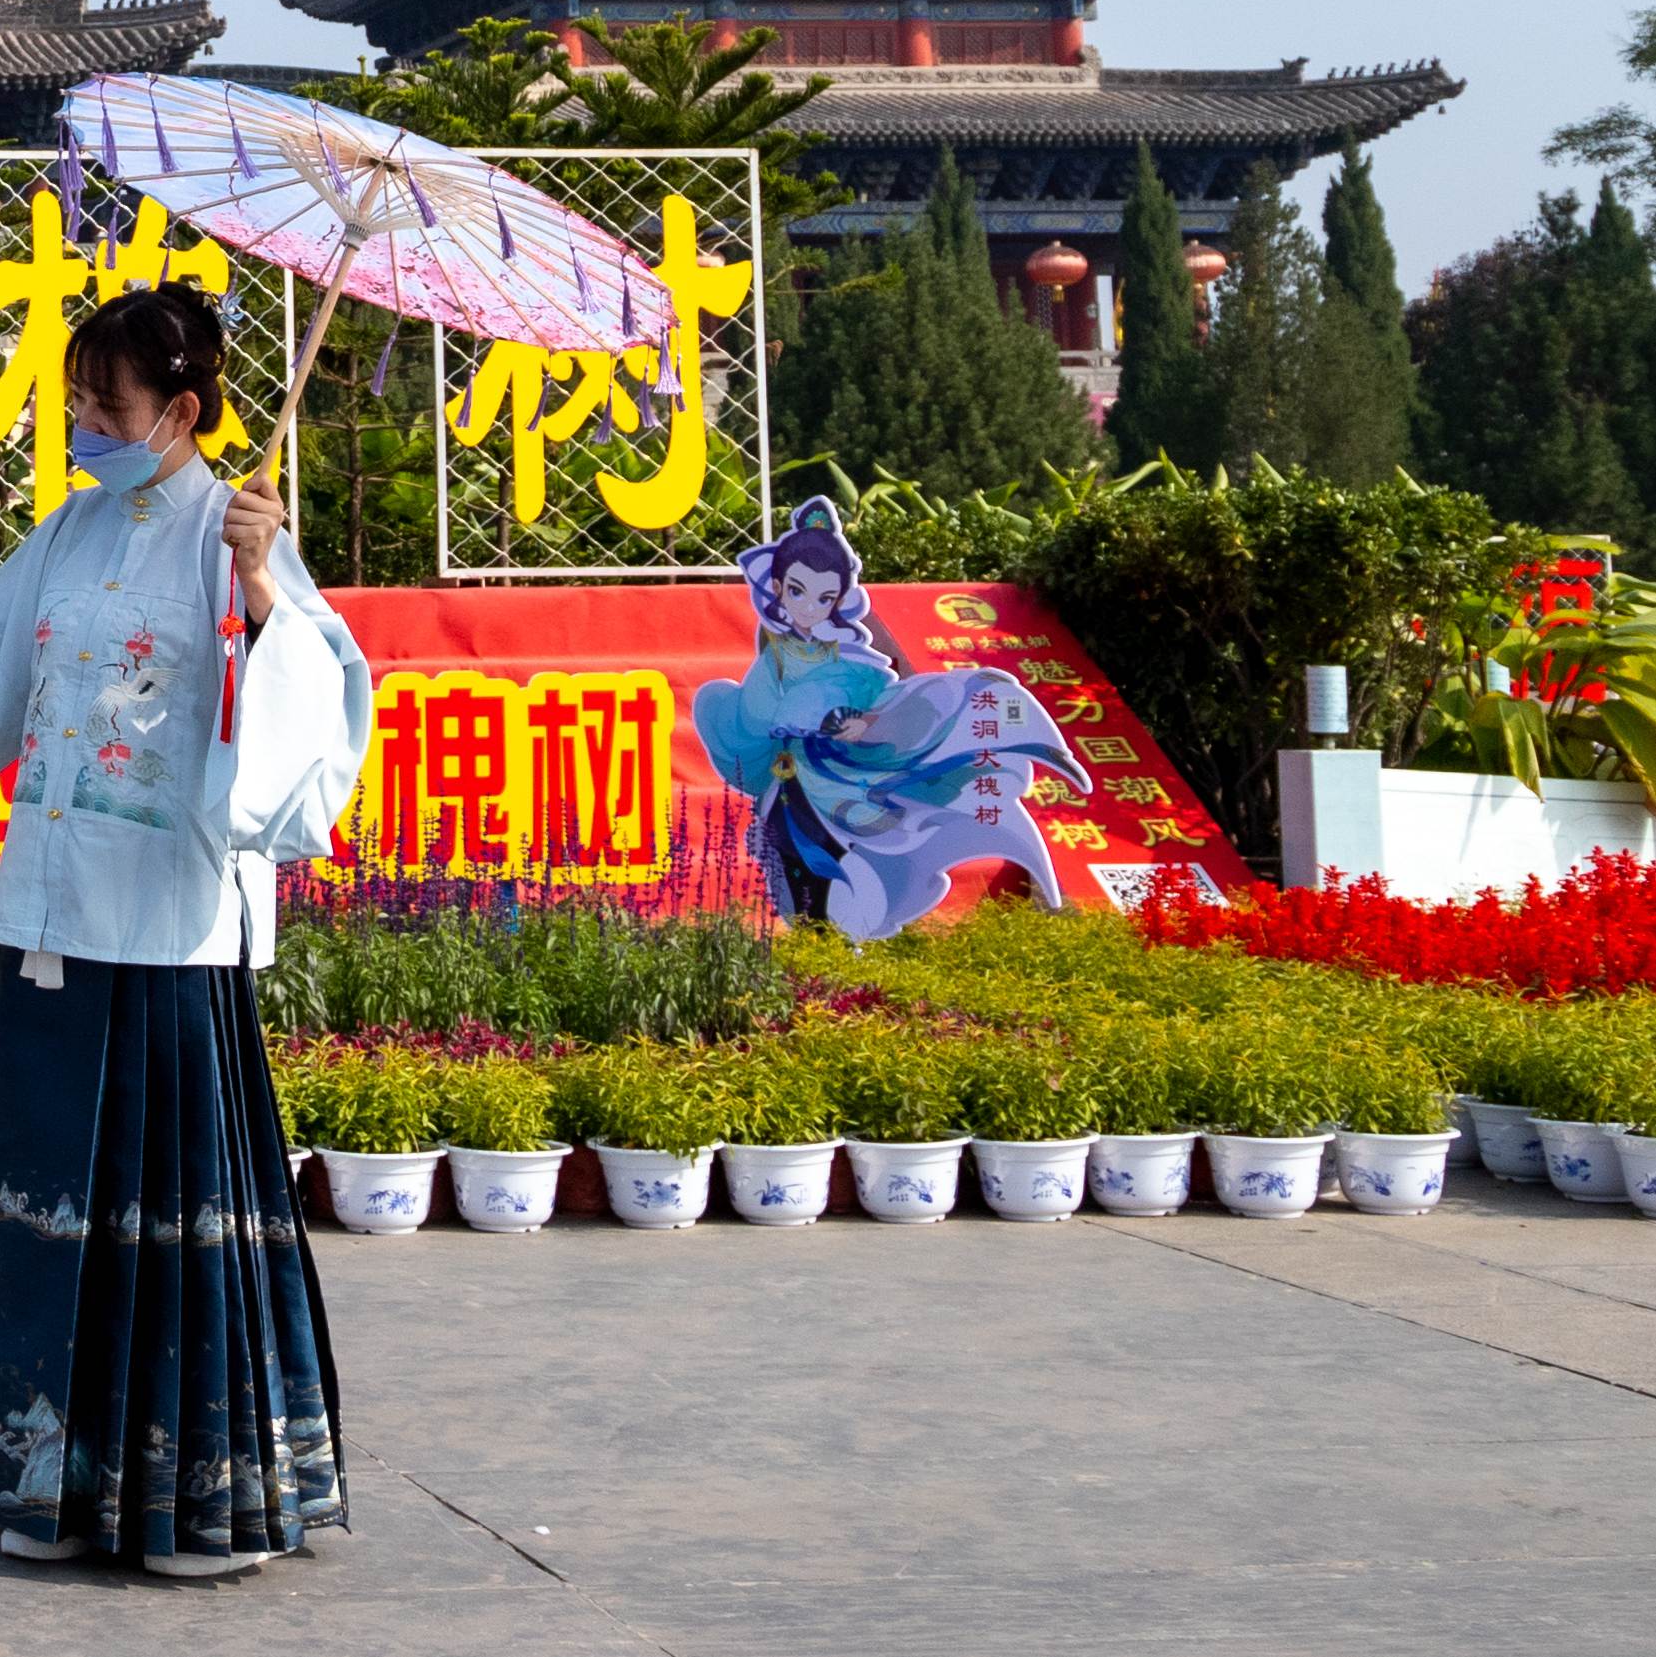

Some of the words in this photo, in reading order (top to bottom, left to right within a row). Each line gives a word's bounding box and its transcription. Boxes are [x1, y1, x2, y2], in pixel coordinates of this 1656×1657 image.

[971, 691, 1003, 826] 洪洞大槐树
[1016, 657, 1206, 848] 魅力国潮风
